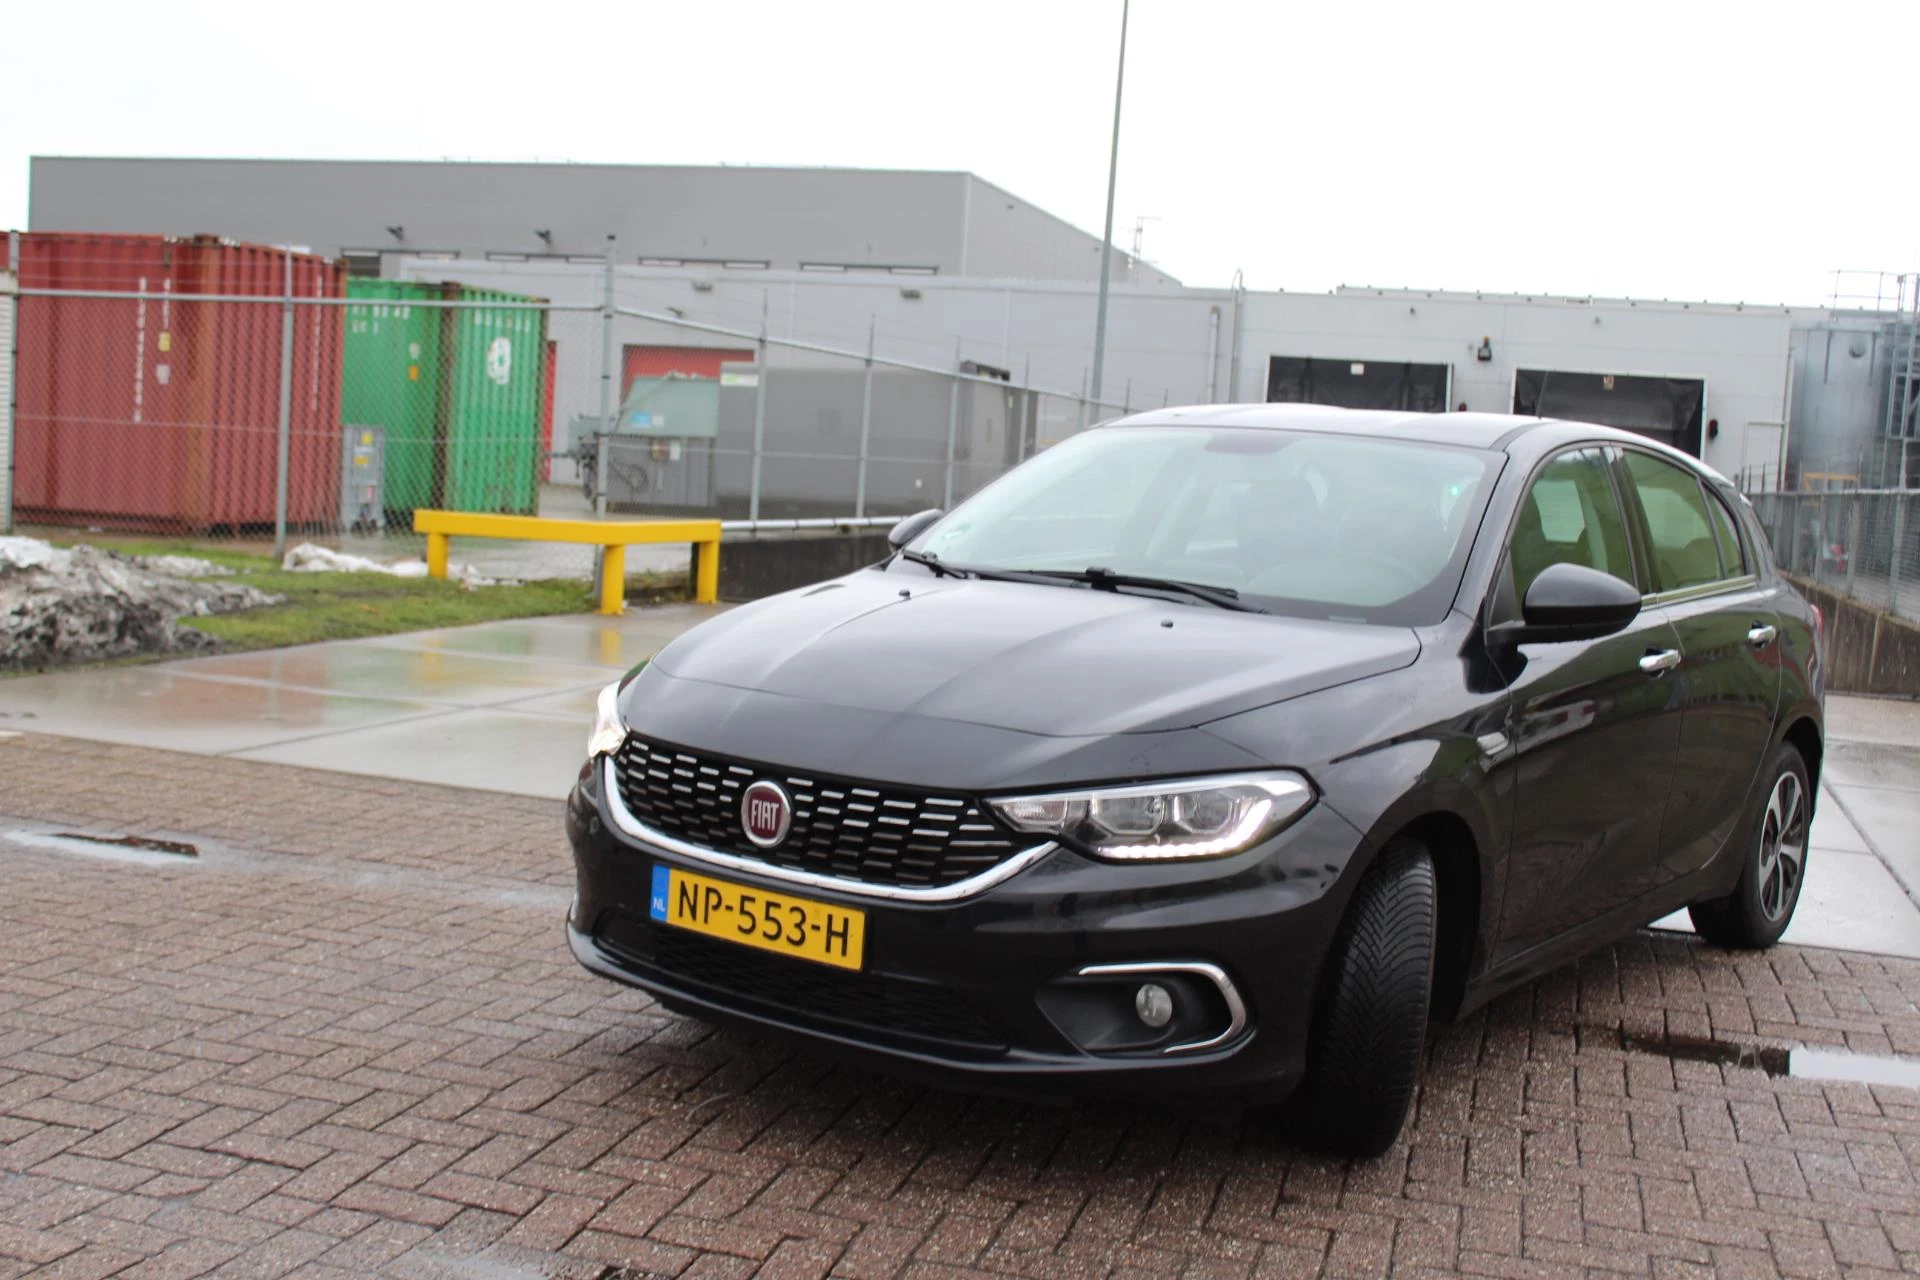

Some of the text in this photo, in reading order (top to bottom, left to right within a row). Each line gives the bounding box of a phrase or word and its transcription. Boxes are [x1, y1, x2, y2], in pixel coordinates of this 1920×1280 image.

[751, 799, 780, 831] FIAT
[653, 897, 666, 912] NL
[678, 879, 850, 957] NP-553-H
